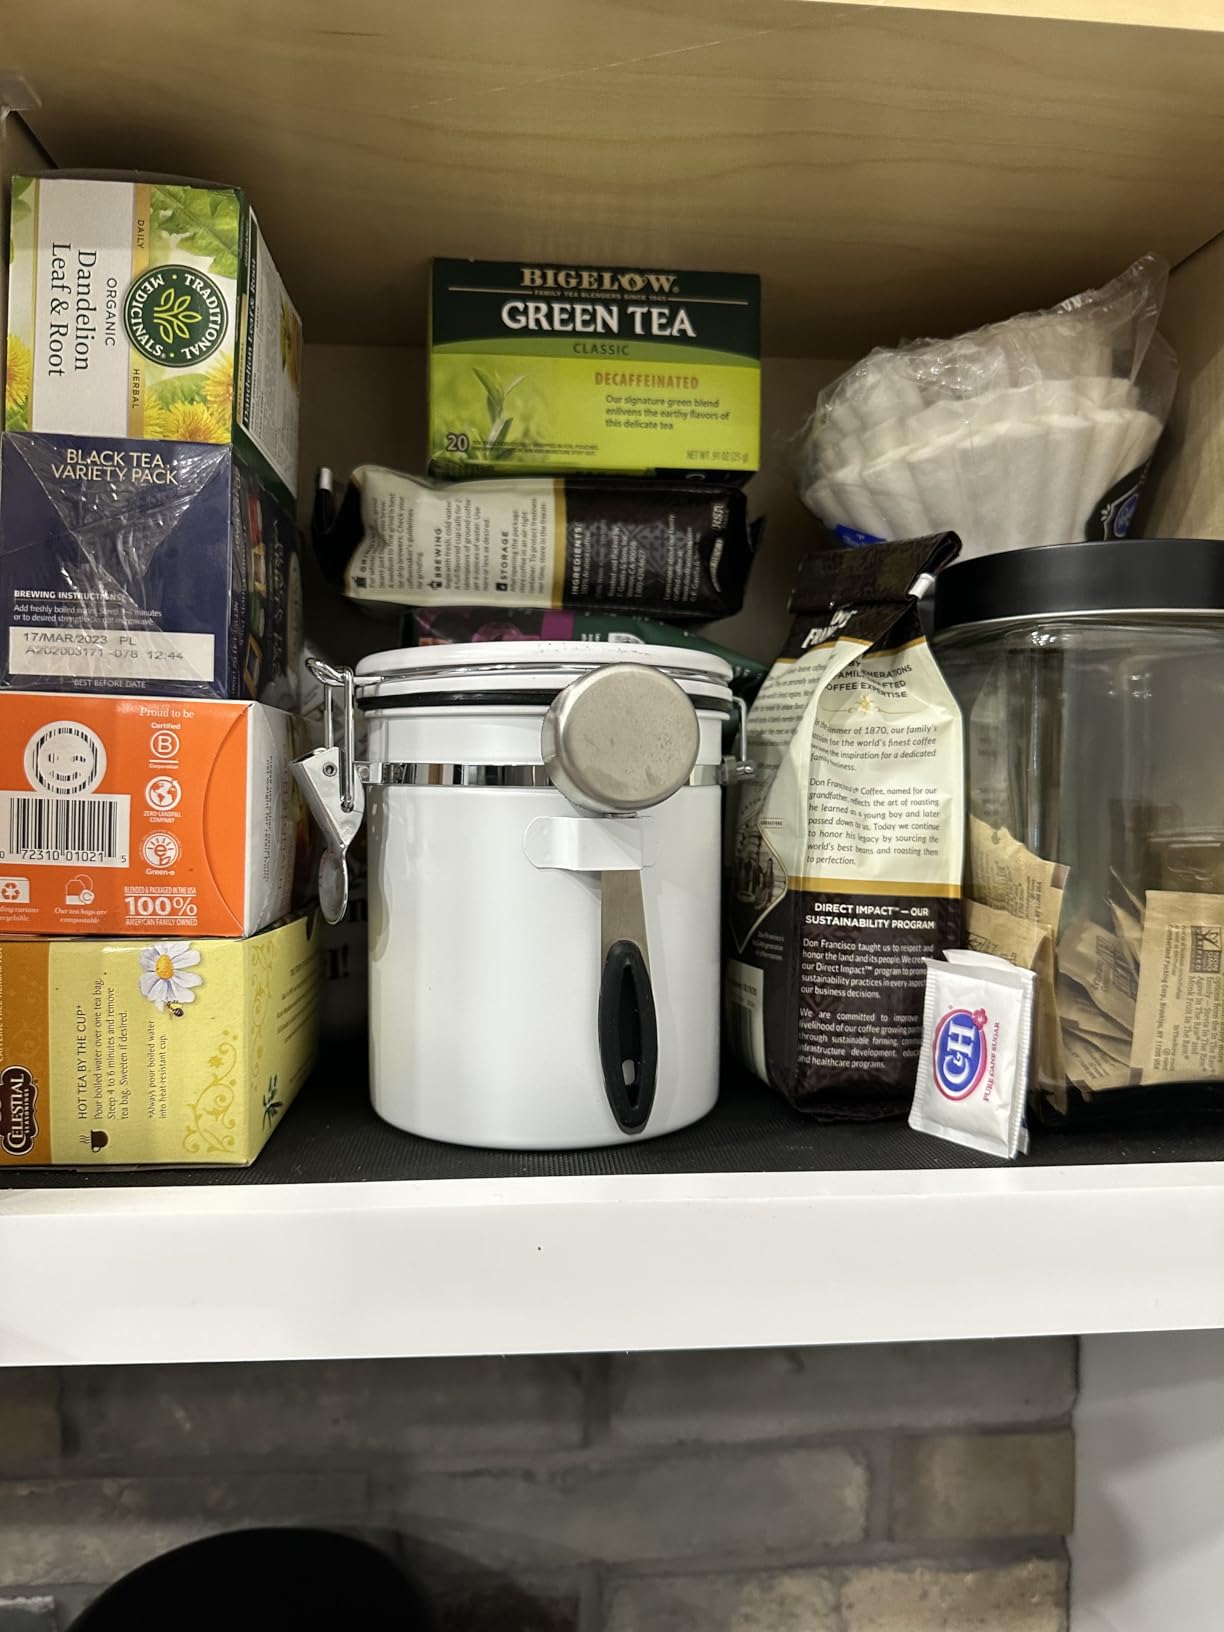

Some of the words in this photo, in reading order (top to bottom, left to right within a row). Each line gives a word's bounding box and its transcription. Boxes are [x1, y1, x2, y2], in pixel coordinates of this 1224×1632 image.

[52, 242, 71, 294] Leaf
[520, 269, 676, 293] BIGELOW
[50, 298, 69, 315] &
[74, 250, 96, 372] Dandelion
[106, 278, 117, 346] ORGANIC
[131, 274, 165, 356] MEDICINALS
[181, 274, 220, 359] TRADITIONAL
[501, 301, 619, 334] GREEN
[627, 306, 696, 337] TEA
[48, 323, 69, 377] Root
[573, 343, 629, 355] CLASSIC
[244, 347, 252, 423] Dandelion
[595, 372, 699, 389] DECAFFEINATED
[606, 395, 622, 403] Our
[625, 397, 664, 406] signature
[667, 399, 692, 407] green
[695, 399, 719, 408] blend
[606, 408, 642, 416] enlivens
[644, 408, 657, 416] the
[660, 410, 688, 420] earthy
[690, 410, 718, 420] flavors
[720, 412, 730, 420] of
[606, 419, 622, 427] this
[624, 420, 658, 429] delicate
[447, 434, 468, 451] 20
[67, 449, 125, 466] BLACK
[129, 452, 164, 468] TEA
[52, 464, 127, 481] VARIETY
[132, 469, 178, 485] PACK
[434, 528, 442, 578] BREWING
[14, 590, 55, 599] BREWING
[31, 605, 53, 613] freshly
[55, 606, 75, 614] boiled
[120, 637, 136, 645] PL
[147, 652, 183, 661] 12:44
[140, 707, 169, 716] Proud
[183, 710, 194, 718] be
[854, 727, 862, 736] of
[865, 727, 888, 735] 1870,
[906, 725, 937, 734] family's
[158, 736, 172, 752] B
[830, 738, 839, 746] for
[913, 737, 936, 745] coffee
[21, 849, 59, 860] 72310
[66, 851, 104, 862] 01021
[808, 843, 834, 851] world's
[855, 846, 873, 854] beans
[894, 847, 920, 856] roasting
[924, 848, 938, 856] them
[816, 857, 855, 865] perfection.
[125, 897, 197, 915] 100%
[814, 903, 853, 913] DIRECT
[911, 908, 928, 916] OUR
[805, 915, 889, 928] SUSTAINABILITY
[892, 920, 934, 929] PROGRAM
[803, 938, 818, 947] Don
[821, 940, 856, 950] Francisco
[858, 943, 880, 952] taught
[923, 944, 934, 952] and
[93, 978, 104, 995] bag.
[1187, 975, 1195, 995] Monk
[93, 998, 101, 1010] tea
[106, 987, 114, 1017] remove
[93, 1012, 101, 1027] one
[105, 1019, 114, 1034] and
[118, 1010, 127, 1042] desired.
[144, 1020, 155, 1041] water
[1183, 1026, 1191, 1039] The
[77, 1035, 86, 1056] THE
[157, 1034, 167, 1050] cup.
[94, 1049, 102, 1071] water
[106, 1037, 115, 1068] minutes
[144, 1043, 155, 1068] boiled
[78, 1059, 87, 1072] BY
[118, 1052, 128, 1085] Sweeten
[983, 1078, 994, 1102] PURE
[992, 1022, 1000, 1051] SUGAR
[78, 1075, 87, 1094] TEA
[93, 1073, 102, 1098] boiled
[106, 1078, 115, 1086] to
[146, 1070, 156, 1088] pour
[157, 1052, 167, 1102] heat-resistant
[118, 1088, 130, 1105] bag.
[7, 1073, 26, 1148] CELESTIAL
[78, 1097, 88, 1119] HOT
[94, 1101, 103, 1119] Pour
[106, 1097, 117, 1119] Steep
[119, 1107, 128, 1119] tea
[157, 1104, 167, 1119] into
